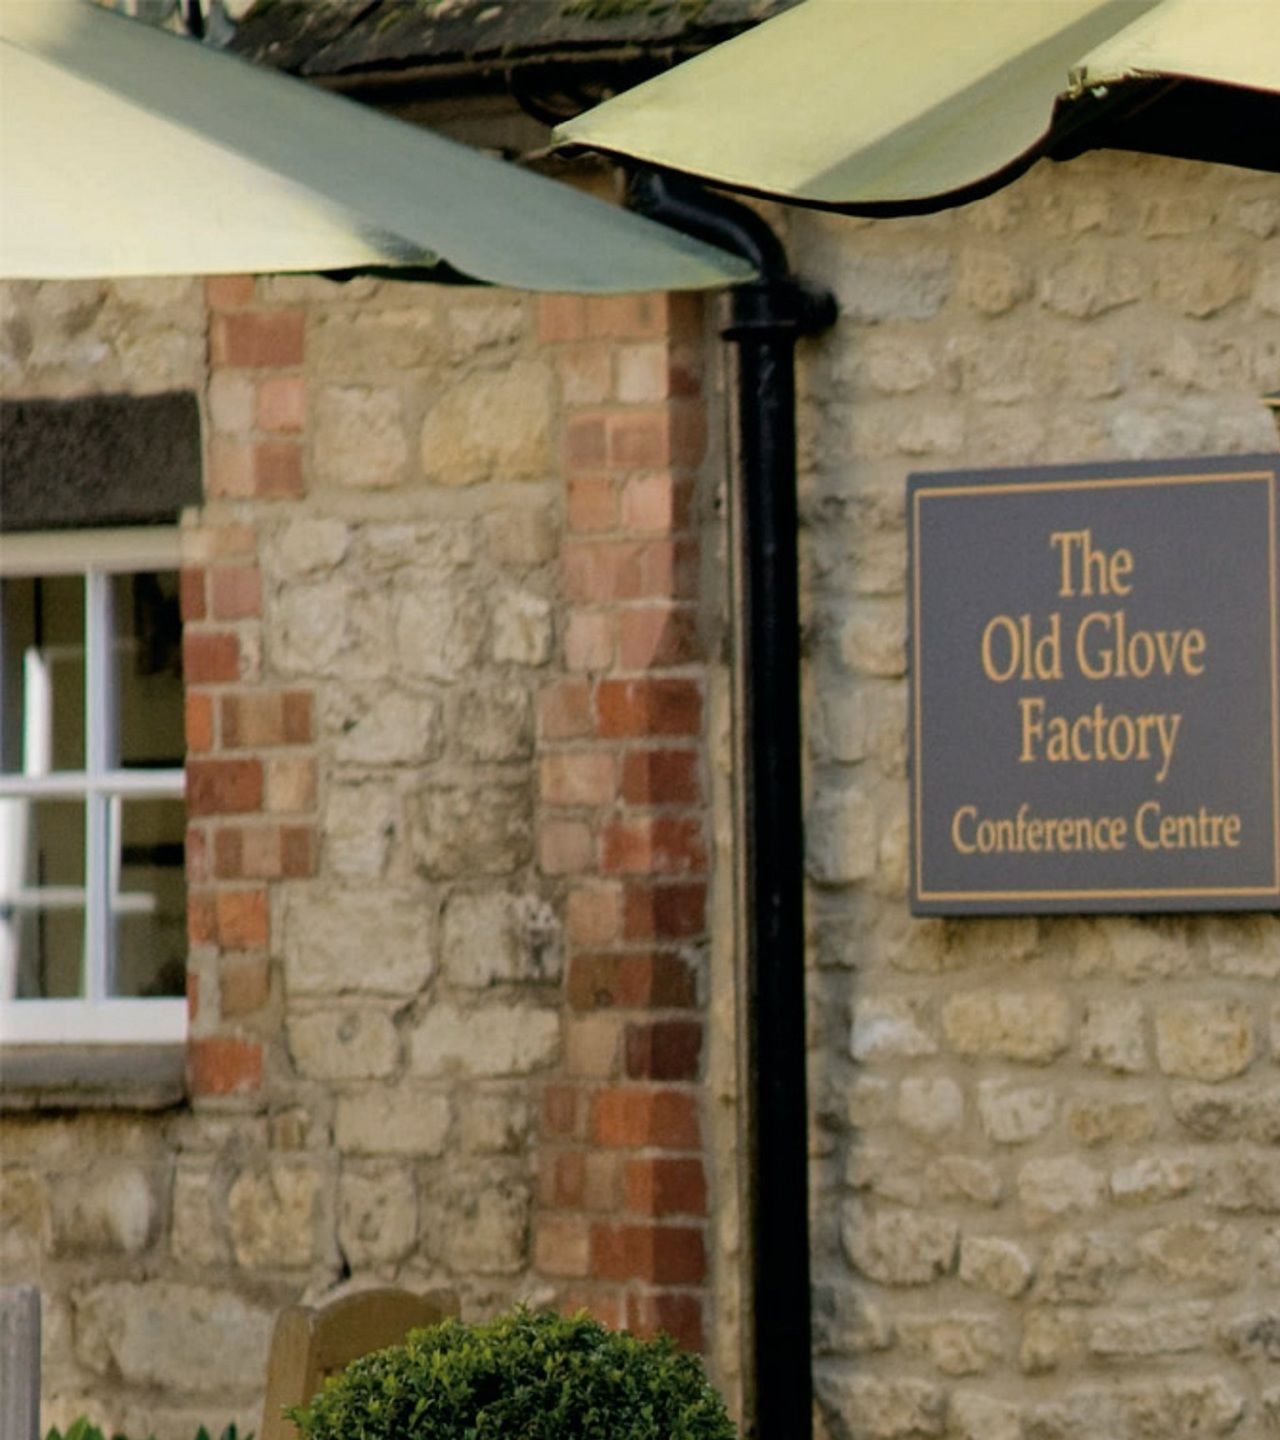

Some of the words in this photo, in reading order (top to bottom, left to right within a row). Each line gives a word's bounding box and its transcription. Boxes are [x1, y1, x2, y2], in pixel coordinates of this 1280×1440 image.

[1050, 528, 1134, 598] The
[981, 612, 1063, 683] Old
[1075, 610, 1206, 680] Glove
[1018, 697, 1182, 783] Factory
[951, 803, 1128, 854] Conference
[1134, 801, 1241, 851] Centre
